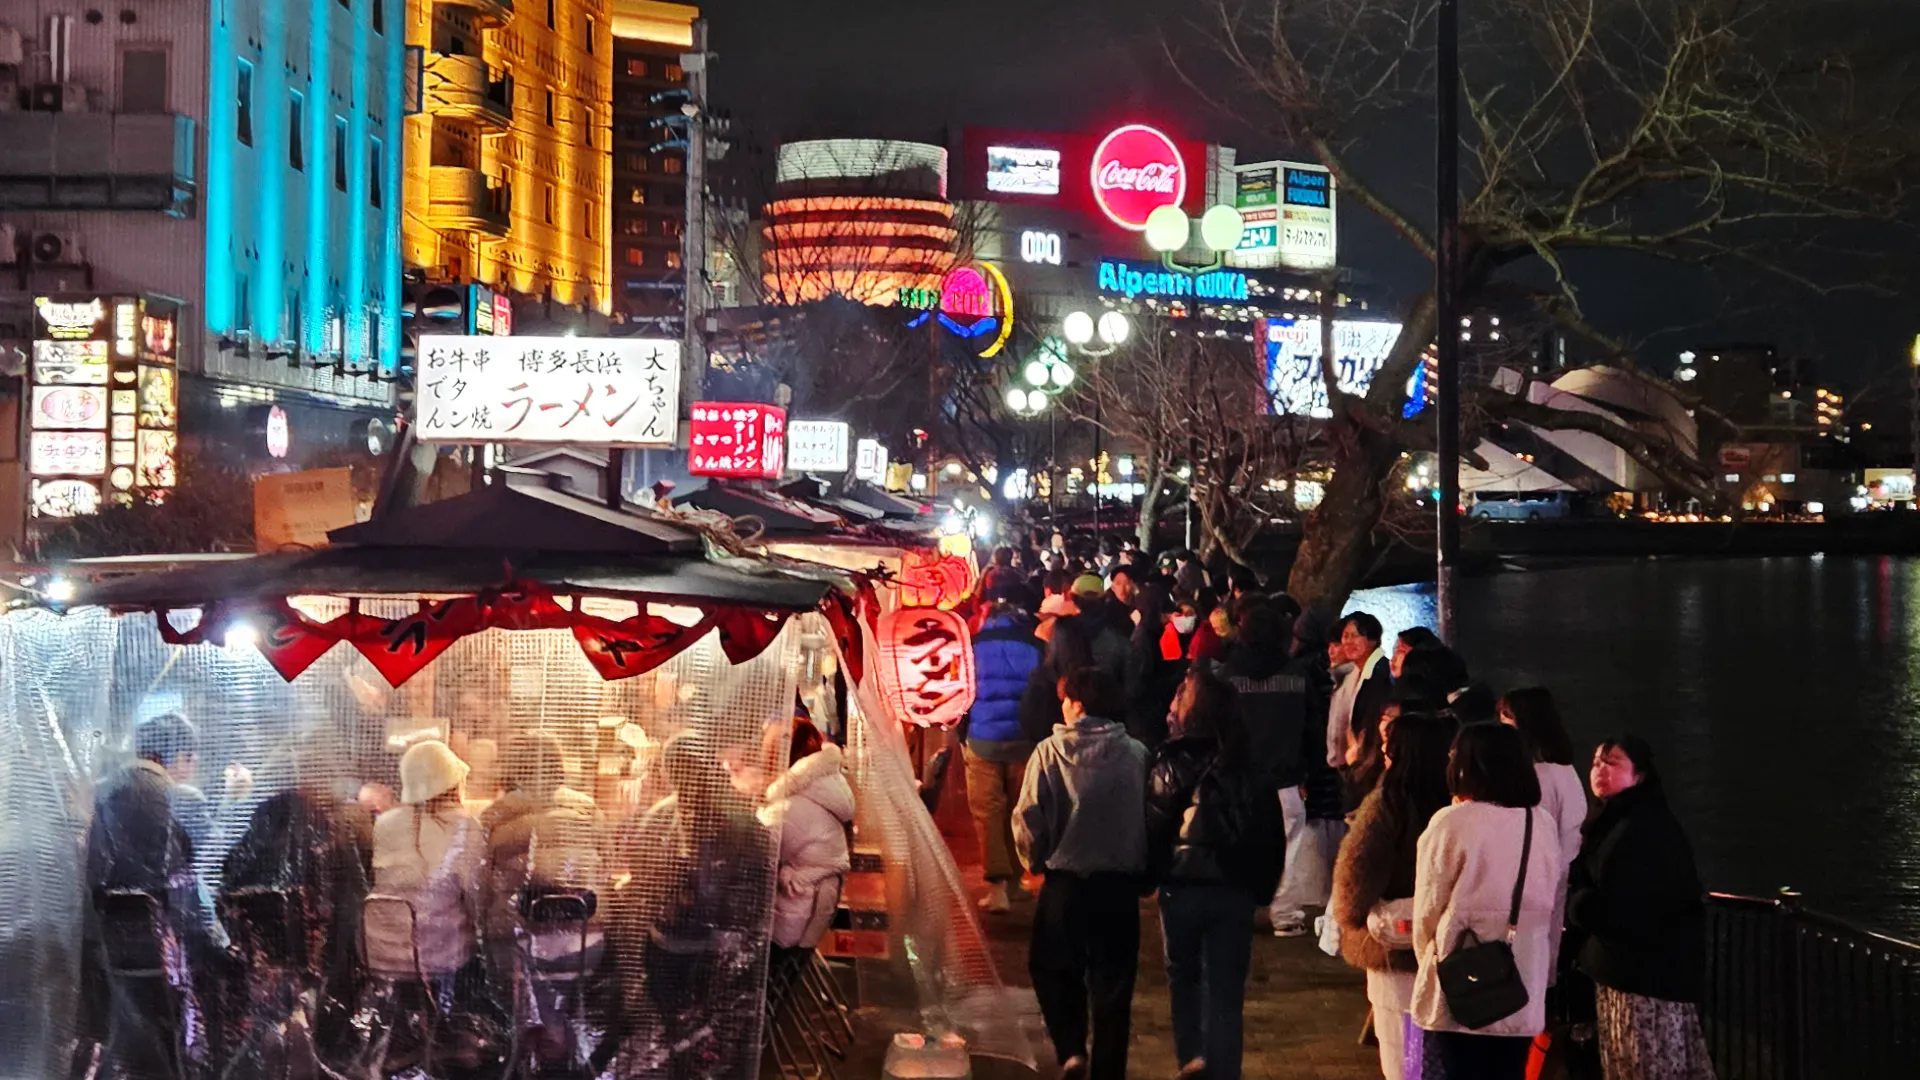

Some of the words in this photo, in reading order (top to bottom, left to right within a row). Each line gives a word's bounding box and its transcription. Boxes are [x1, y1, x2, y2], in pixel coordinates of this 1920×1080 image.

[1099, 160, 1179, 193] Coca-Cola
[1289, 170, 1325, 186] Alpen
[1098, 262, 1176, 298] Alpen
[519, 349, 623, 375] 博多長浜
[501, 382, 640, 432] ラーメン
[642, 347, 667, 437] 大ちゃん
[745, 409, 759, 469] ラーメン
